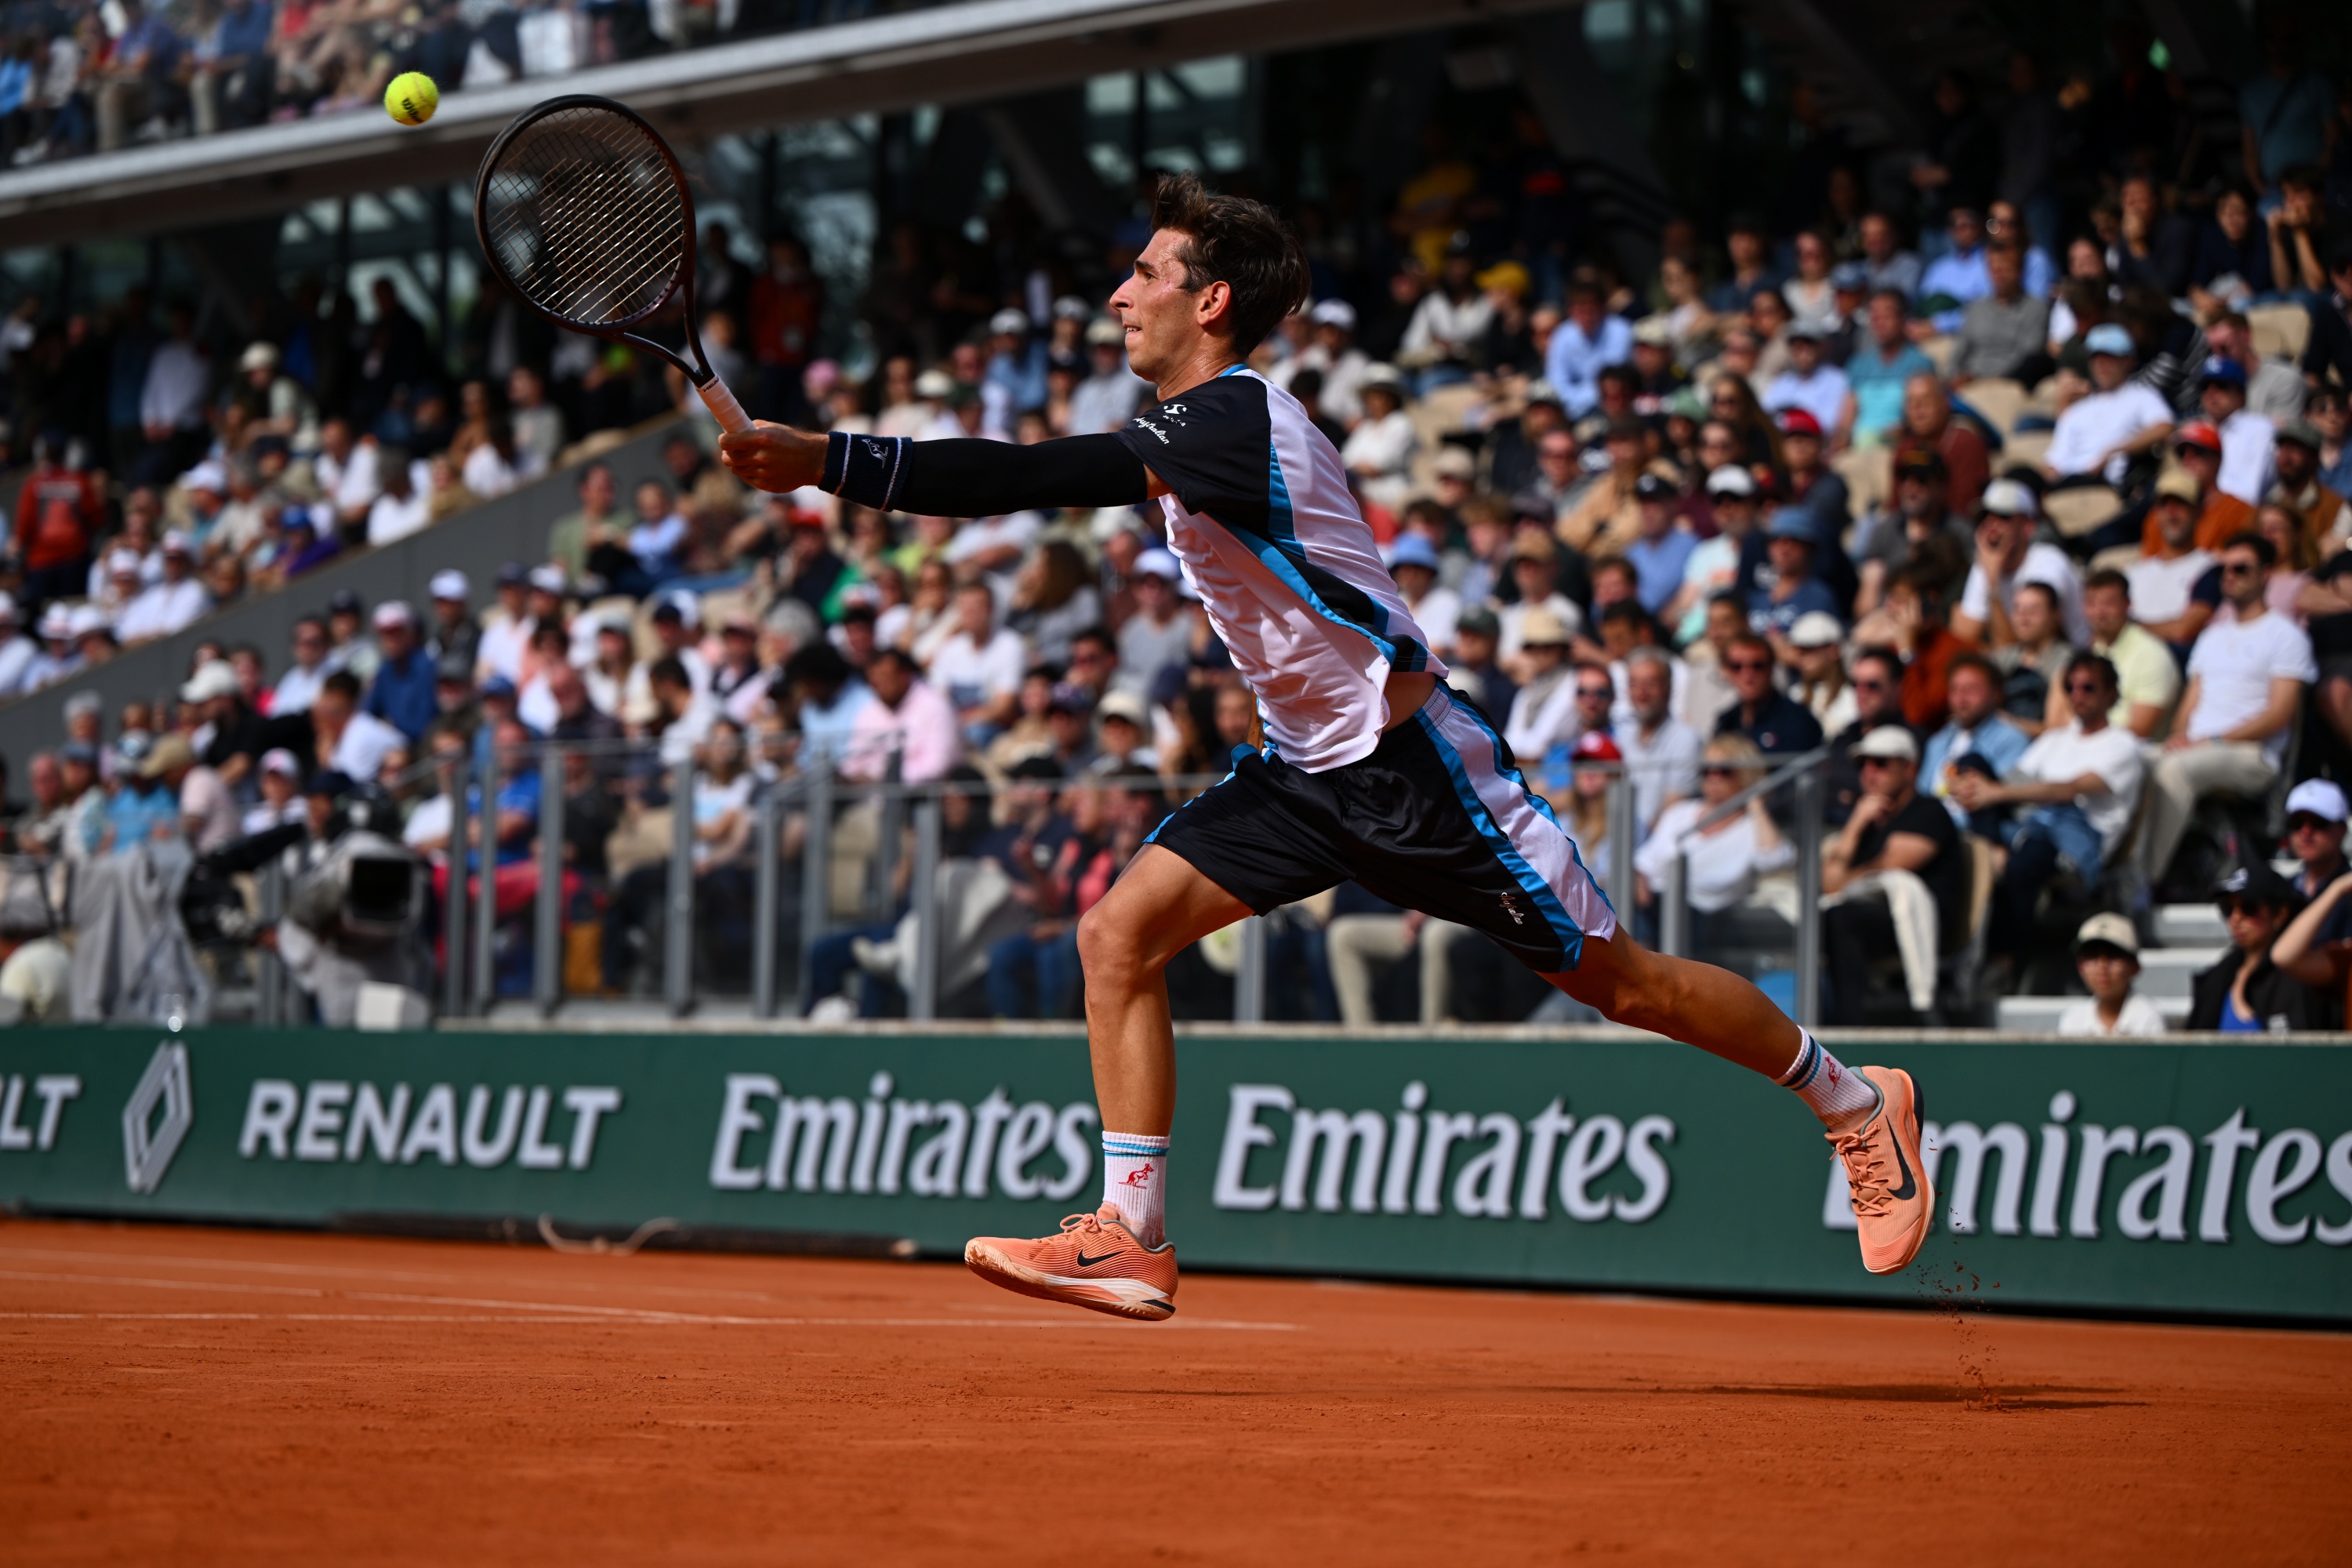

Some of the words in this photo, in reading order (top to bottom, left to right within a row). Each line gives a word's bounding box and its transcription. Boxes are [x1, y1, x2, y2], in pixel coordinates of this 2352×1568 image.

[703, 377, 720, 393] HEA
[1133, 416, 1170, 445] Australian
[0, 1074, 82, 1150] LT
[238, 1079, 622, 1170] RENAULT
[709, 1070, 1098, 1201] Emirates
[1212, 1080, 1676, 1223] Emirates
